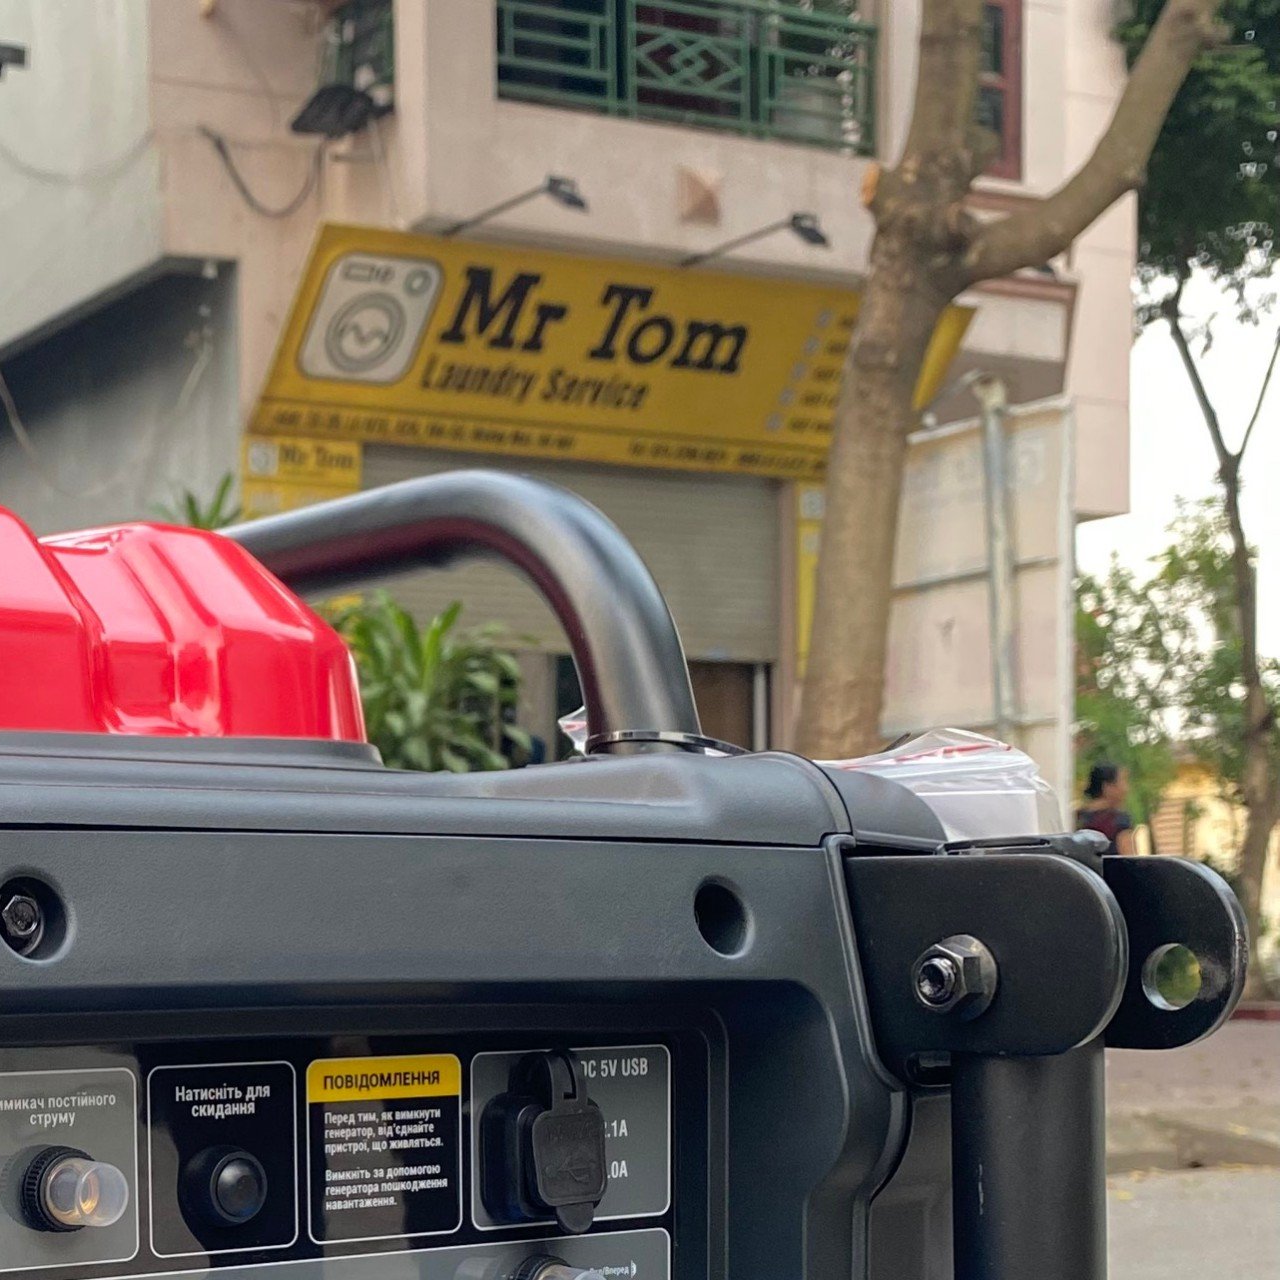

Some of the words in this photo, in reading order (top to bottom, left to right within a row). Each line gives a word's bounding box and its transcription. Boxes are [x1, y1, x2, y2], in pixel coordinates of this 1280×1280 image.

[441, 266, 565, 353] Mr
[591, 285, 748, 374] Tom
[421, 355, 532, 403] Laundry
[540, 367, 649, 410] Service
[600, 1059, 618, 1077] 5V
[622, 1058, 648, 1076] USB
[323, 1070, 440, 1091] ПОВІДОМЛЕННЯ
[48, 1091, 116, 1110] постійного
[175, 1085, 242, 1102] Натисніть
[245, 1084, 271, 1100] для
[29, 1110, 76, 1127] струму
[191, 1101, 256, 1119] скидання
[324, 1111, 355, 1126] Перед
[358, 1112, 379, 1123] тим,
[381, 1111, 393, 1121] як
[395, 1108, 441, 1121] вимкнути
[325, 1127, 376, 1141] генератор,
[604, 1120, 628, 1138] .1A
[325, 1140, 370, 1155] пристрої,
[372, 1140, 387, 1152] що
[389, 1138, 444, 1149] живляться.
[325, 1167, 371, 1181] Вимкніть
[373, 1168, 384, 1178] за
[386, 1164, 441, 1179] допомогою
[607, 1160, 628, 1178] .0A
[325, 1183, 379, 1197] генератора
[381, 1178, 448, 1191] пошкодження
[326, 1196, 397, 1210] навантаження.
